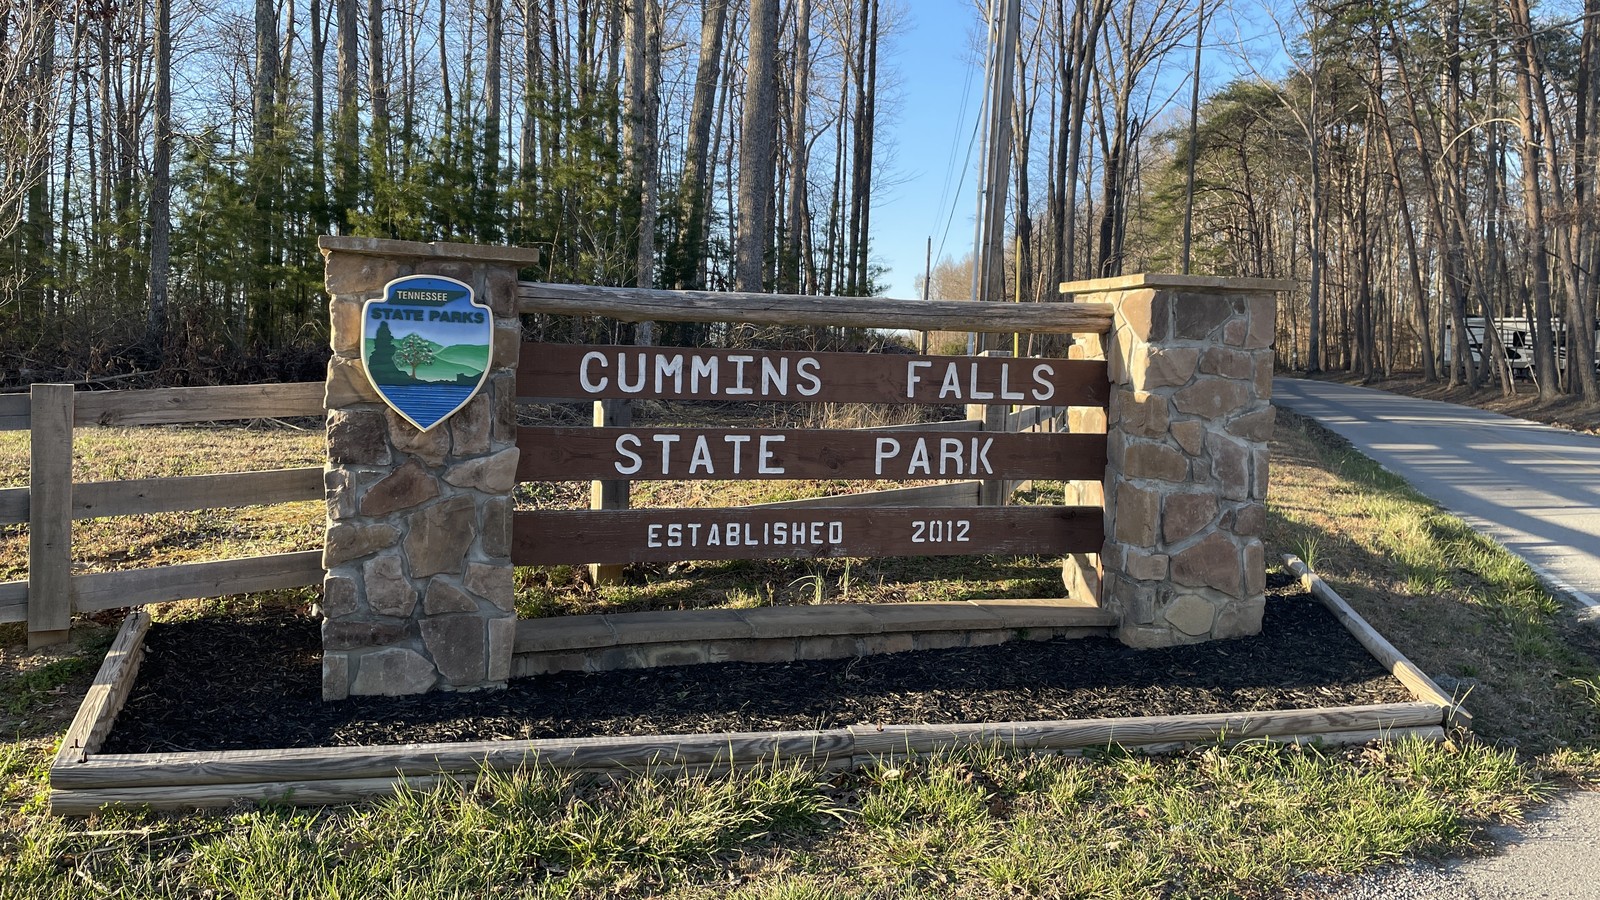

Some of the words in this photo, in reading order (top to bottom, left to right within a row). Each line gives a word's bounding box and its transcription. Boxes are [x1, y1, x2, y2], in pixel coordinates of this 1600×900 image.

[397, 290, 448, 302] TENNESSEE
[371, 307, 424, 321] STATE
[429, 310, 485, 324] PARKS
[580, 352, 821, 395] CUMMINS
[907, 360, 1054, 400] FALLS
[615, 434, 785, 474] STATE
[875, 438, 993, 474] PARK
[648, 522, 842, 547] ESTABLISHED
[912, 520, 969, 542] 2012
